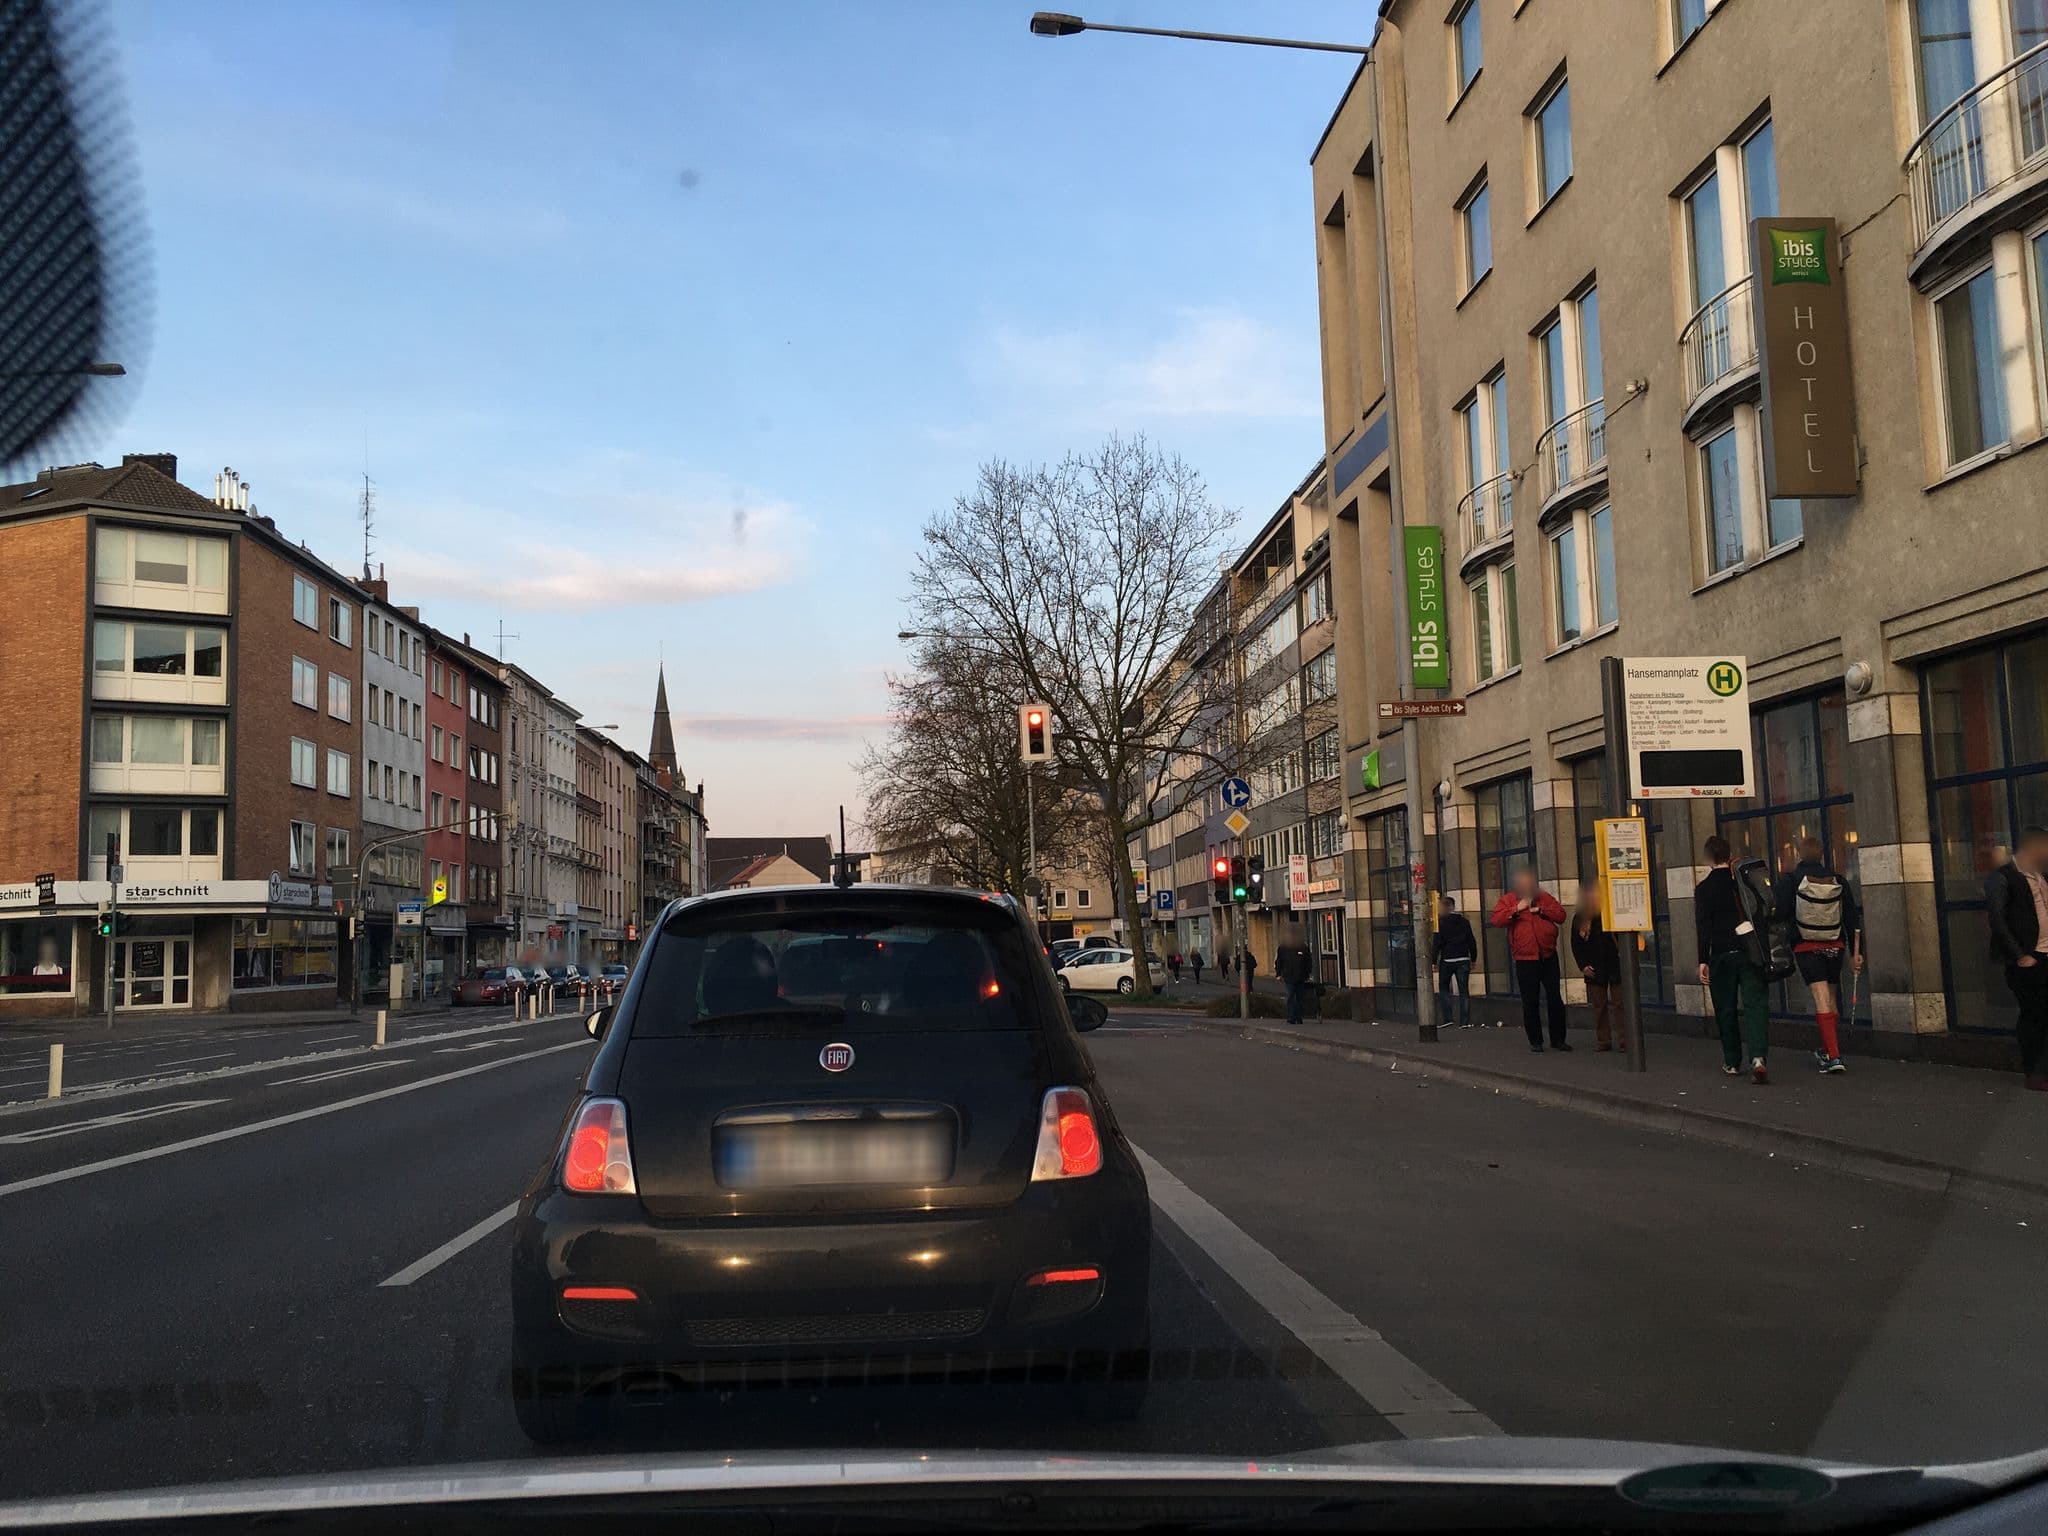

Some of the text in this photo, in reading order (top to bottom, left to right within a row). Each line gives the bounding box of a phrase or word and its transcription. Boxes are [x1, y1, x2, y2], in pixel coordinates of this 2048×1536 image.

[1783, 239, 1814, 256] ibis
[1794, 306, 1822, 473] HOTEL
[1412, 620, 1439, 667] ibis
[1627, 668, 1699, 679] Hansemannplatz
[1715, 668, 1734, 689] H
[1404, 705, 1420, 714] Styles
[1441, 704, 1452, 712] City
[126, 885, 209, 896] starschnitt
[1160, 892, 1170, 908] P
[827, 1050, 849, 1065] FIAT
